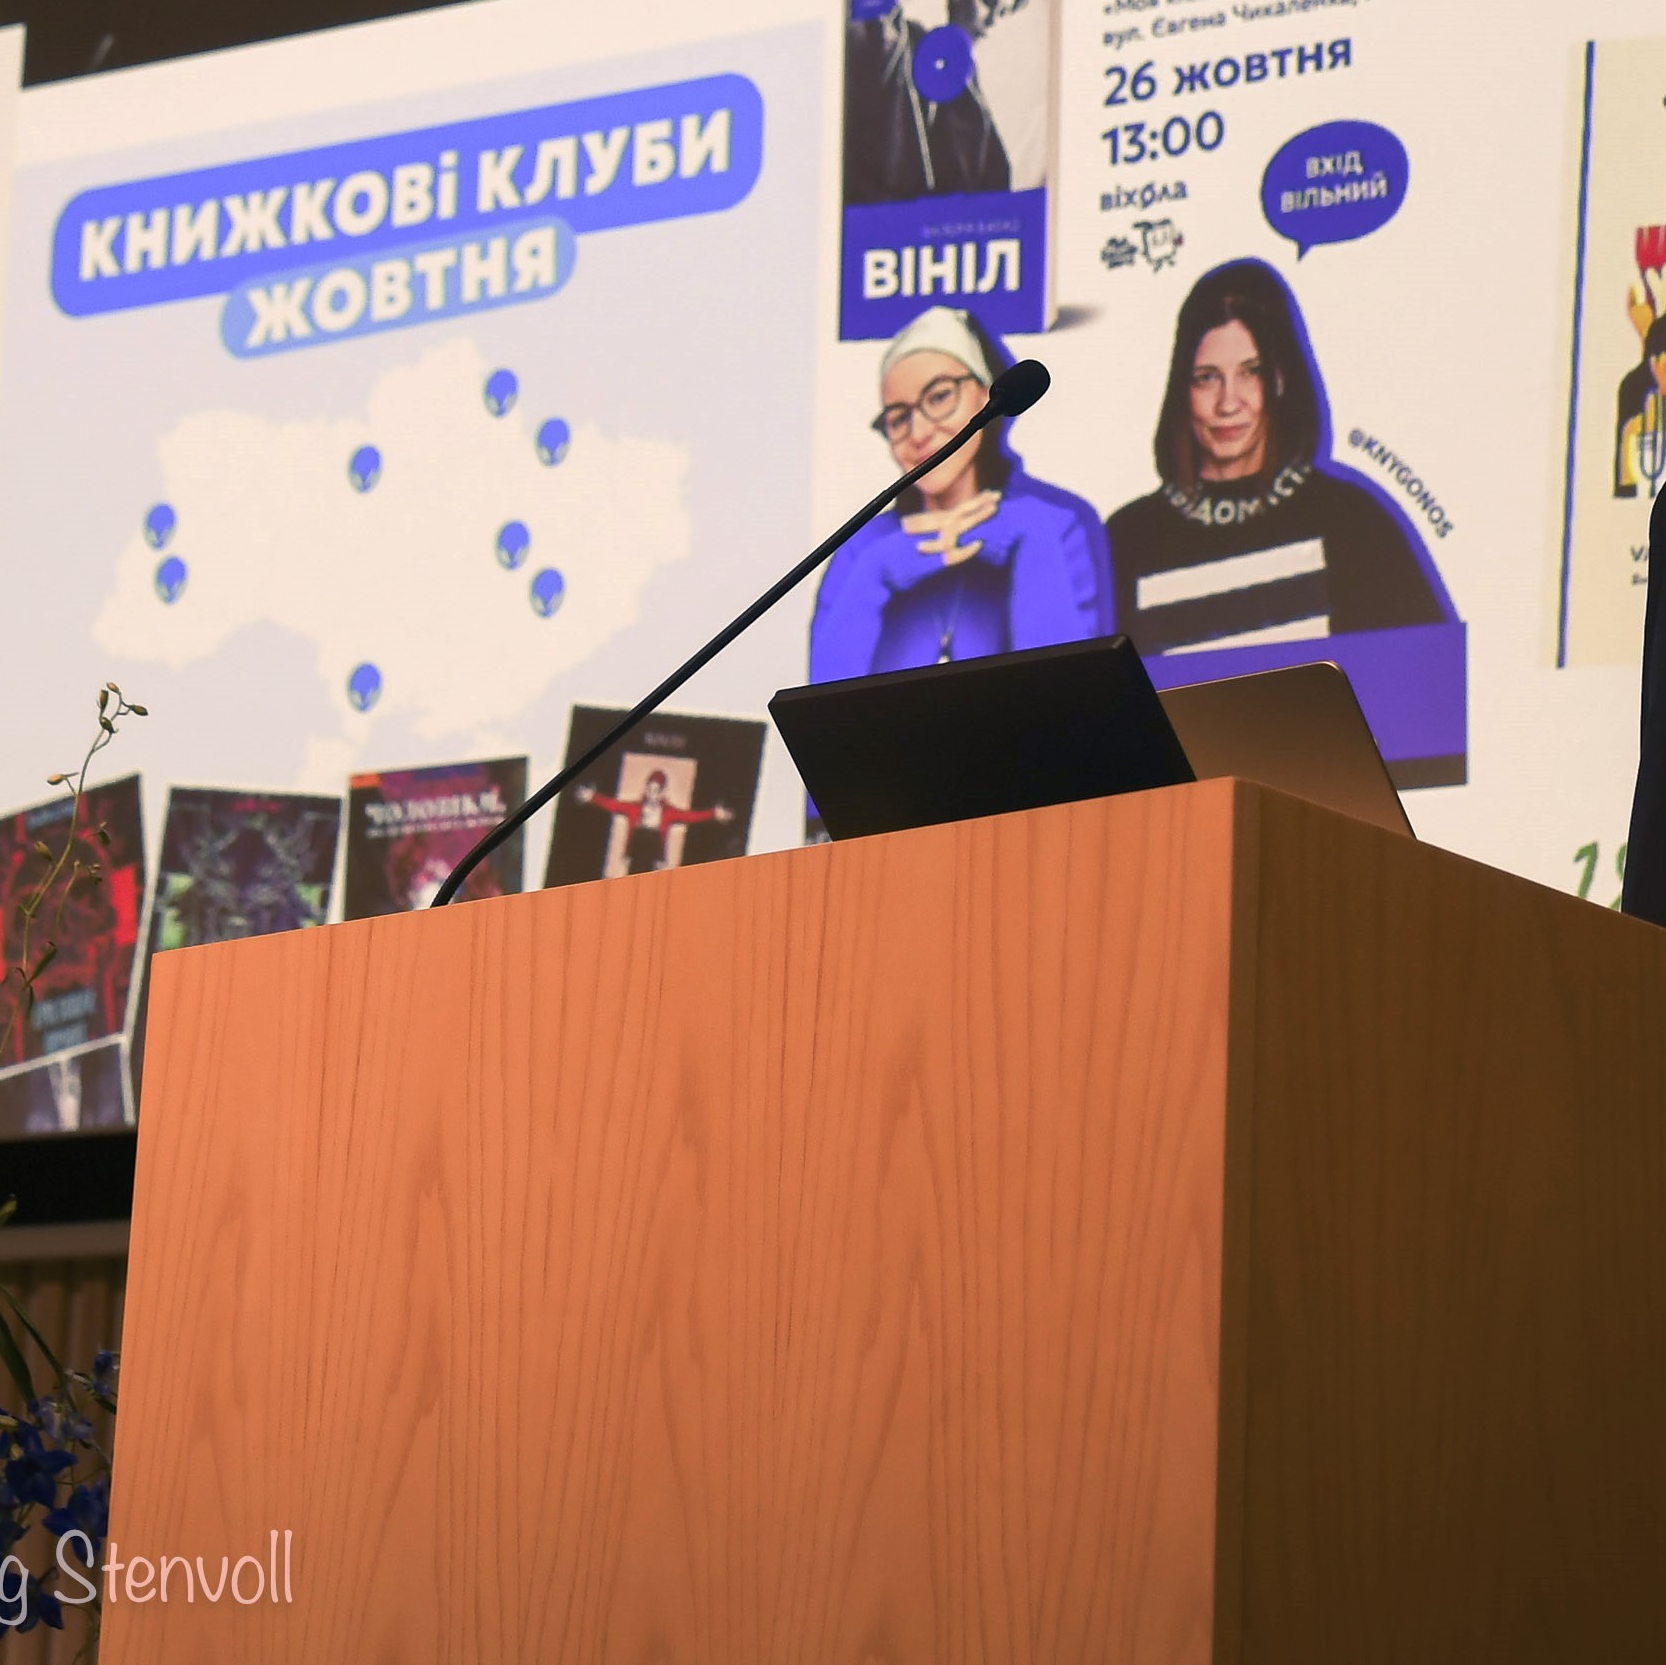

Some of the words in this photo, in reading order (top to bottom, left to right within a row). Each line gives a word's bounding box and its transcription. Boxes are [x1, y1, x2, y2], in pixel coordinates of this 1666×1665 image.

[1104, 59, 1158, 107] 26
[477, 107, 731, 213] КЛУБИ
[1101, 111, 1225, 165] 13:00
[1306, 149, 1364, 180] ВХІД
[1280, 170, 1389, 214] ВІЛЬНИЙ
[243, 224, 557, 349] ЖОВТНЯ
[863, 238, 1021, 300] ВІНІЛ
